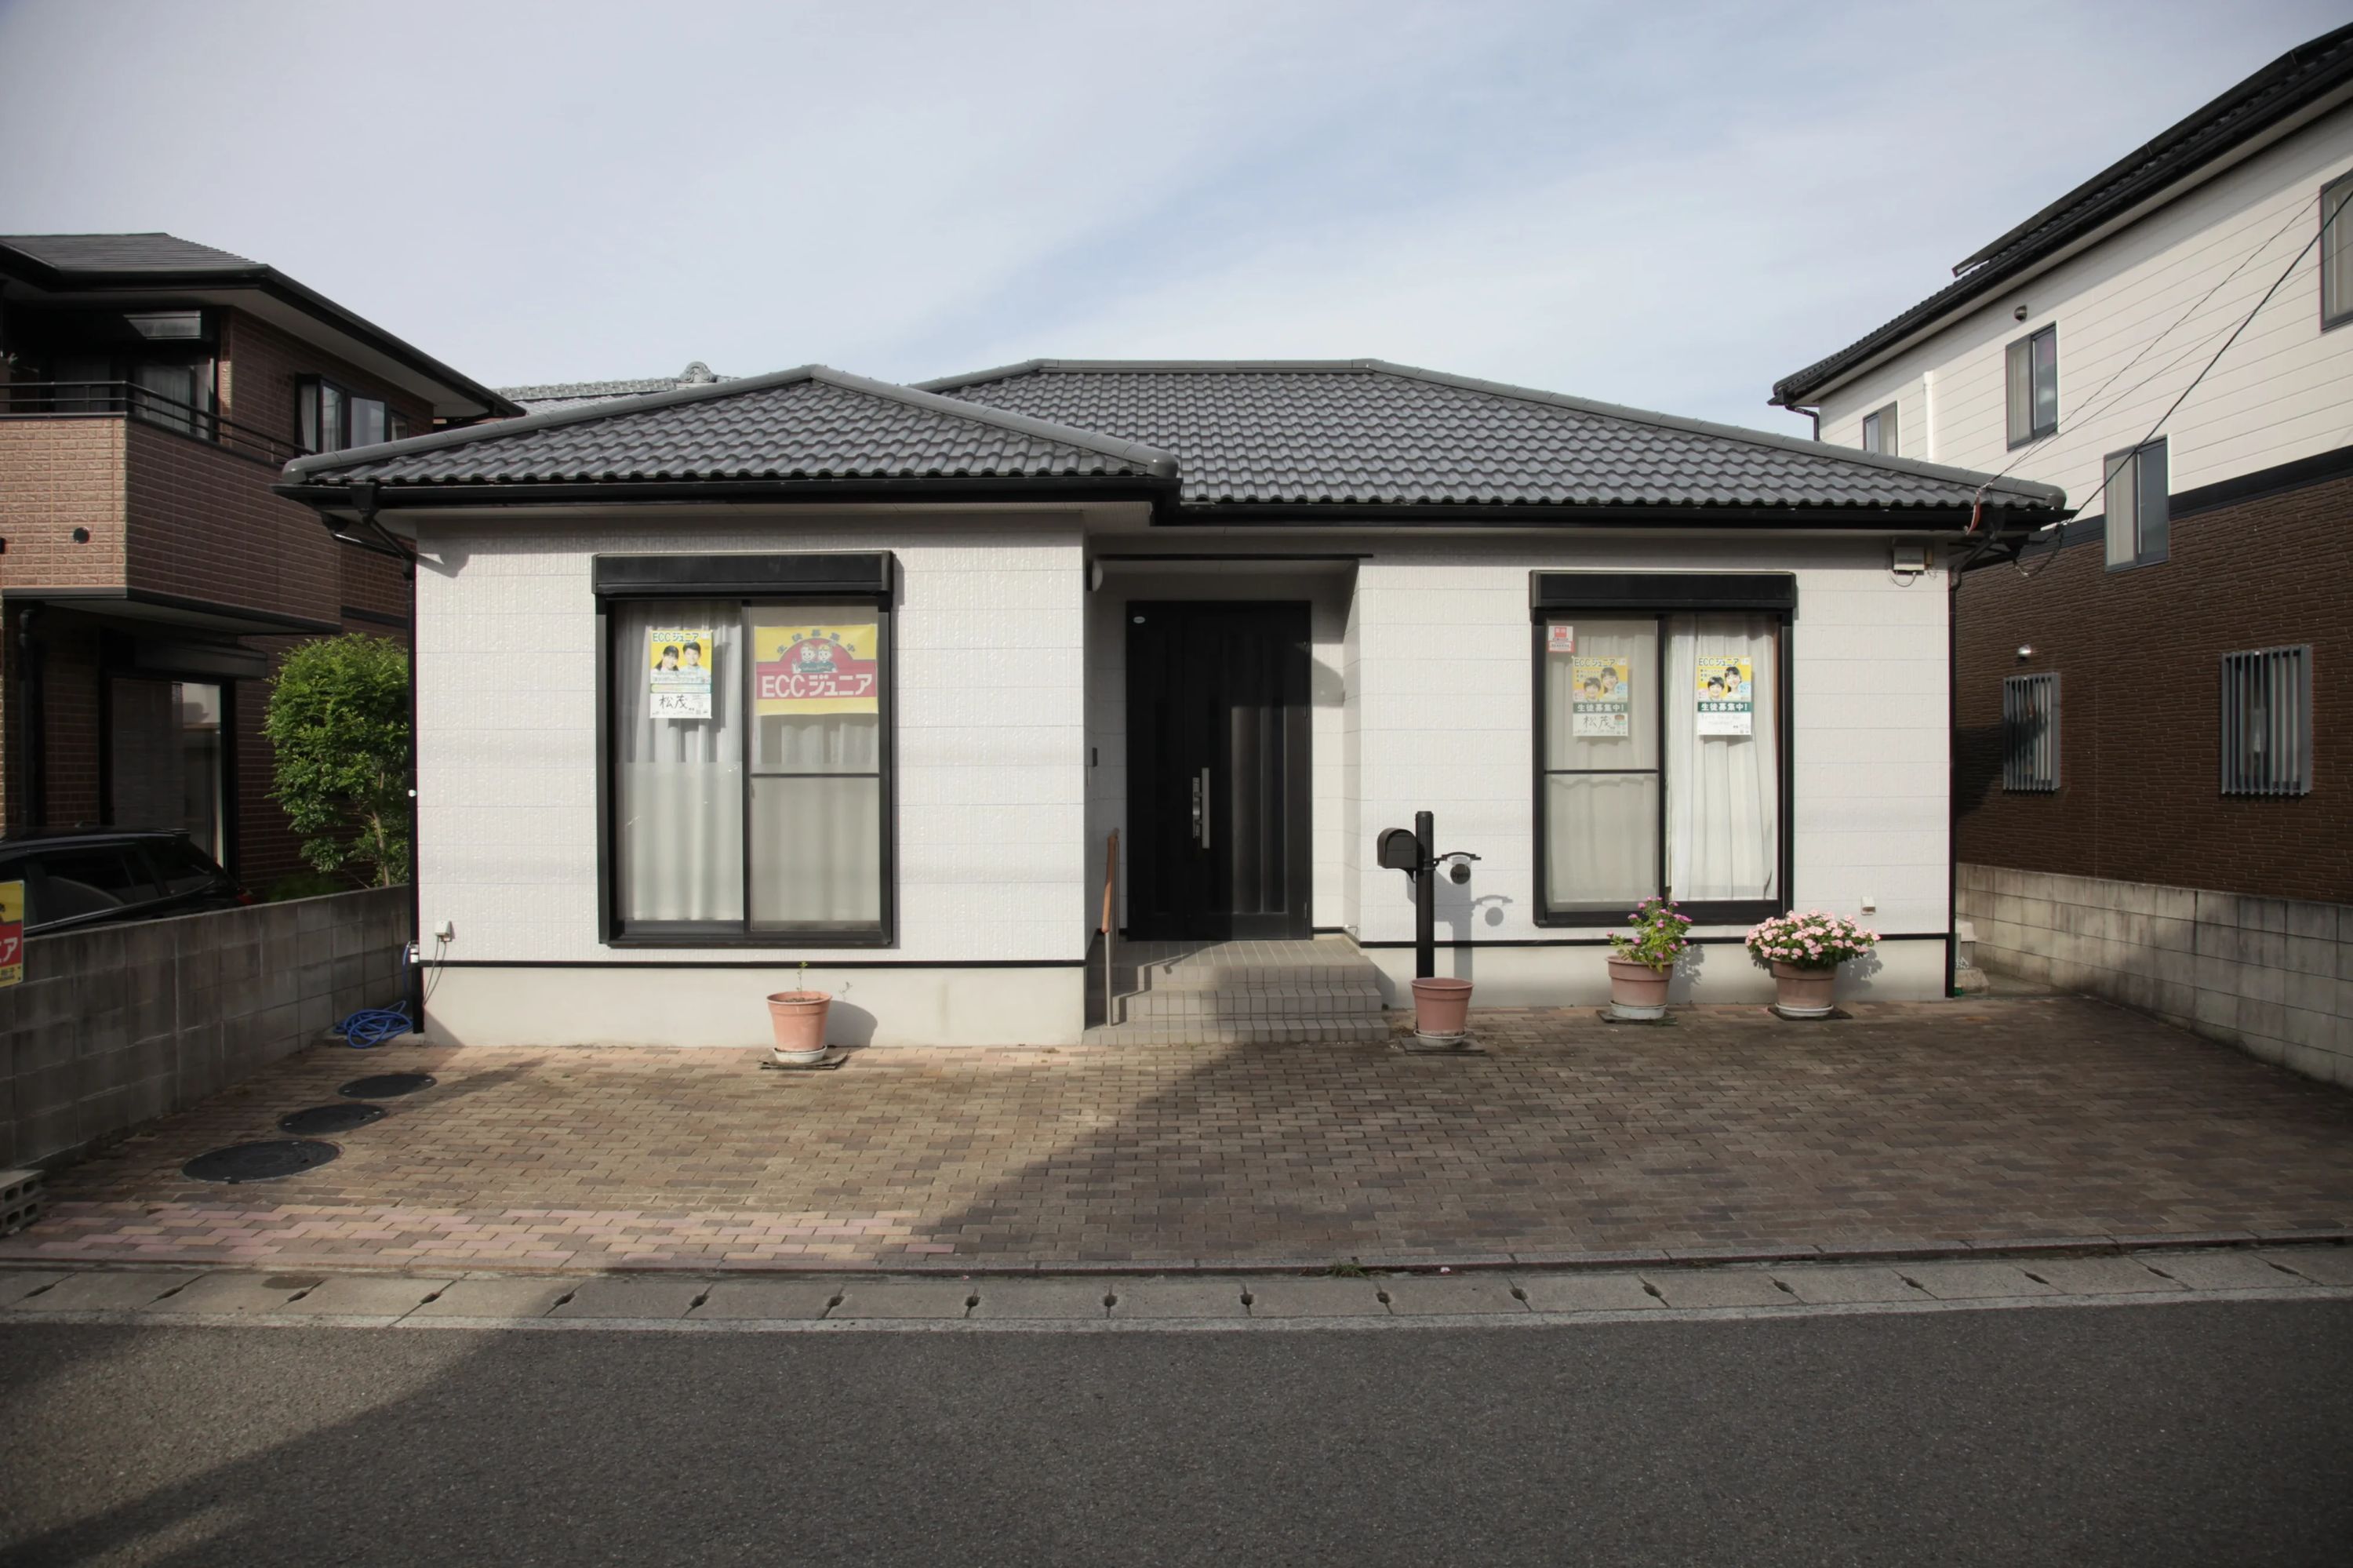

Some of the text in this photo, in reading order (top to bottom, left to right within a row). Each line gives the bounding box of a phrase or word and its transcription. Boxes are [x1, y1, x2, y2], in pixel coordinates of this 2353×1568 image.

[653, 632, 699, 642] ECCジュニア
[762, 673, 872, 697] ECCジュニア
[1701, 703, 1747, 711] 生徒募集中!
